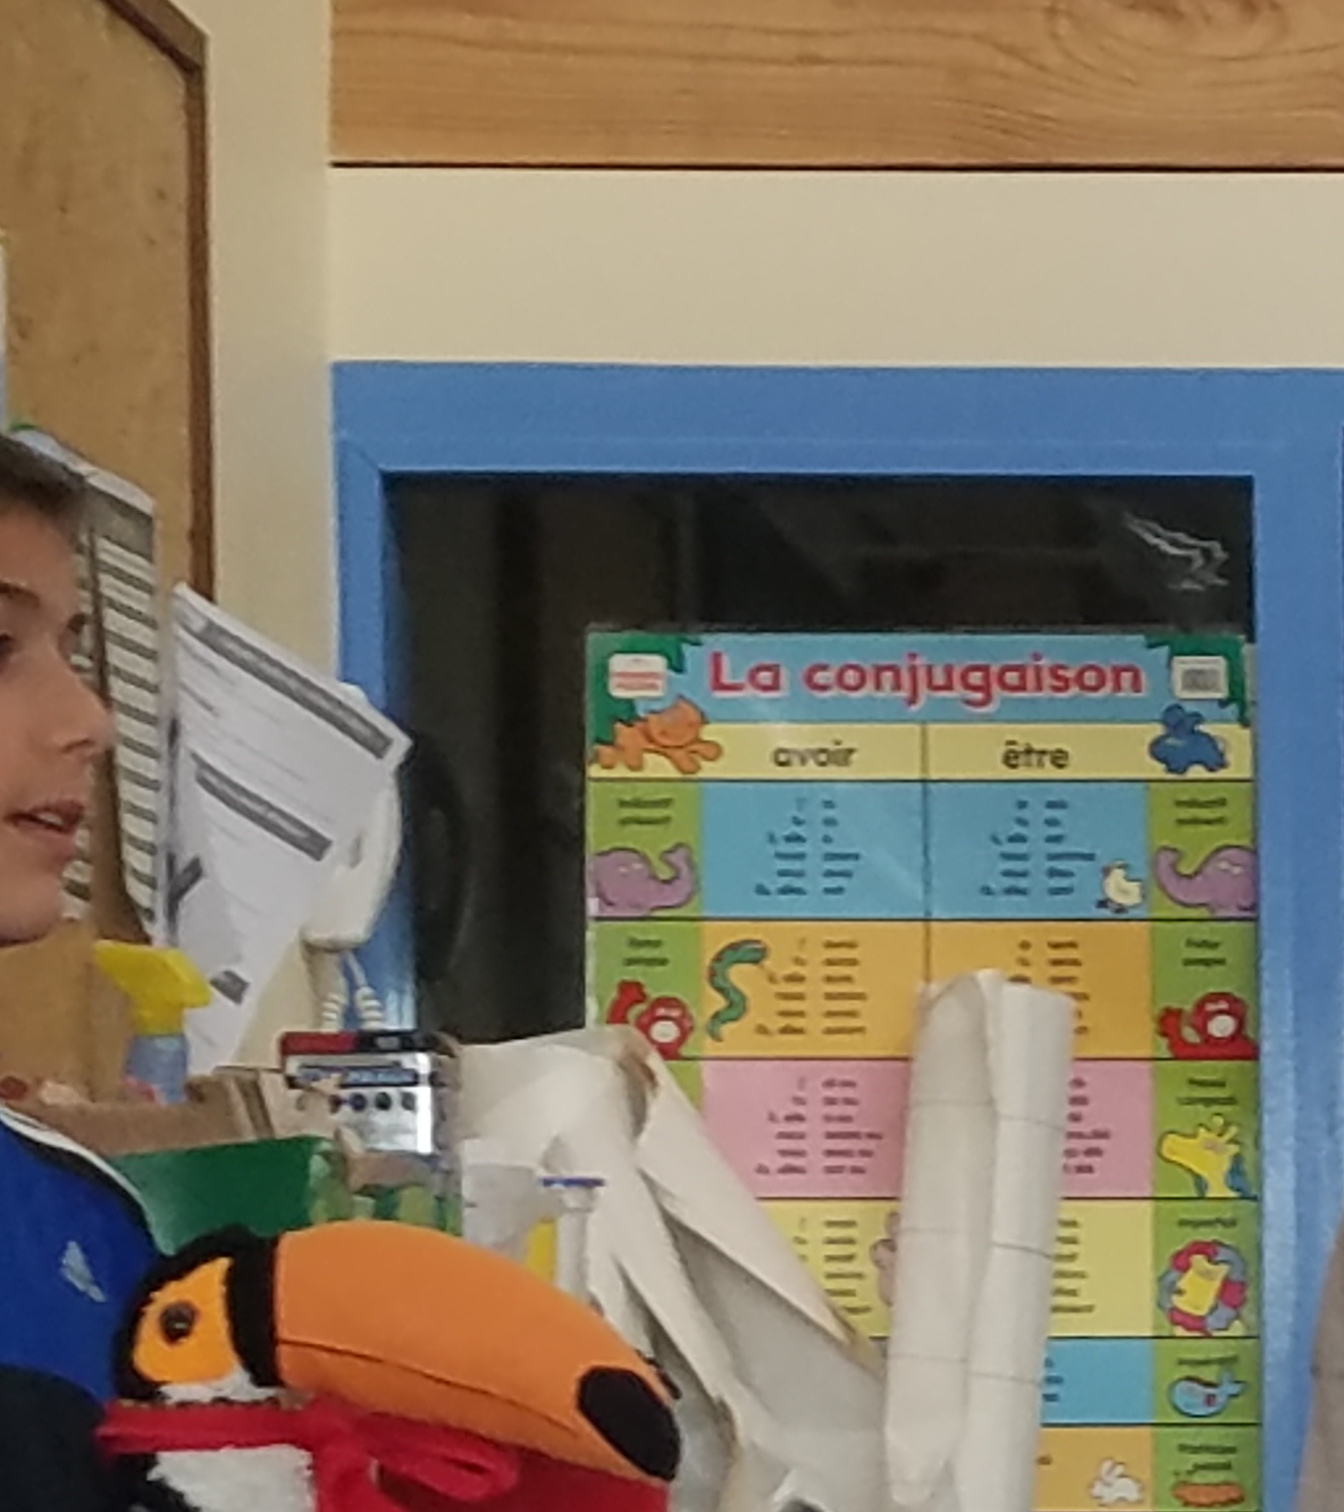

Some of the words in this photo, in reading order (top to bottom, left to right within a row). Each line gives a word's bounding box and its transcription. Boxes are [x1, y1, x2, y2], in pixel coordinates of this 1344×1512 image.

[711, 652, 781, 693] La
[804, 652, 1143, 707] conjugaison
[773, 741, 857, 768] avoir
[1002, 740, 1069, 769] être
